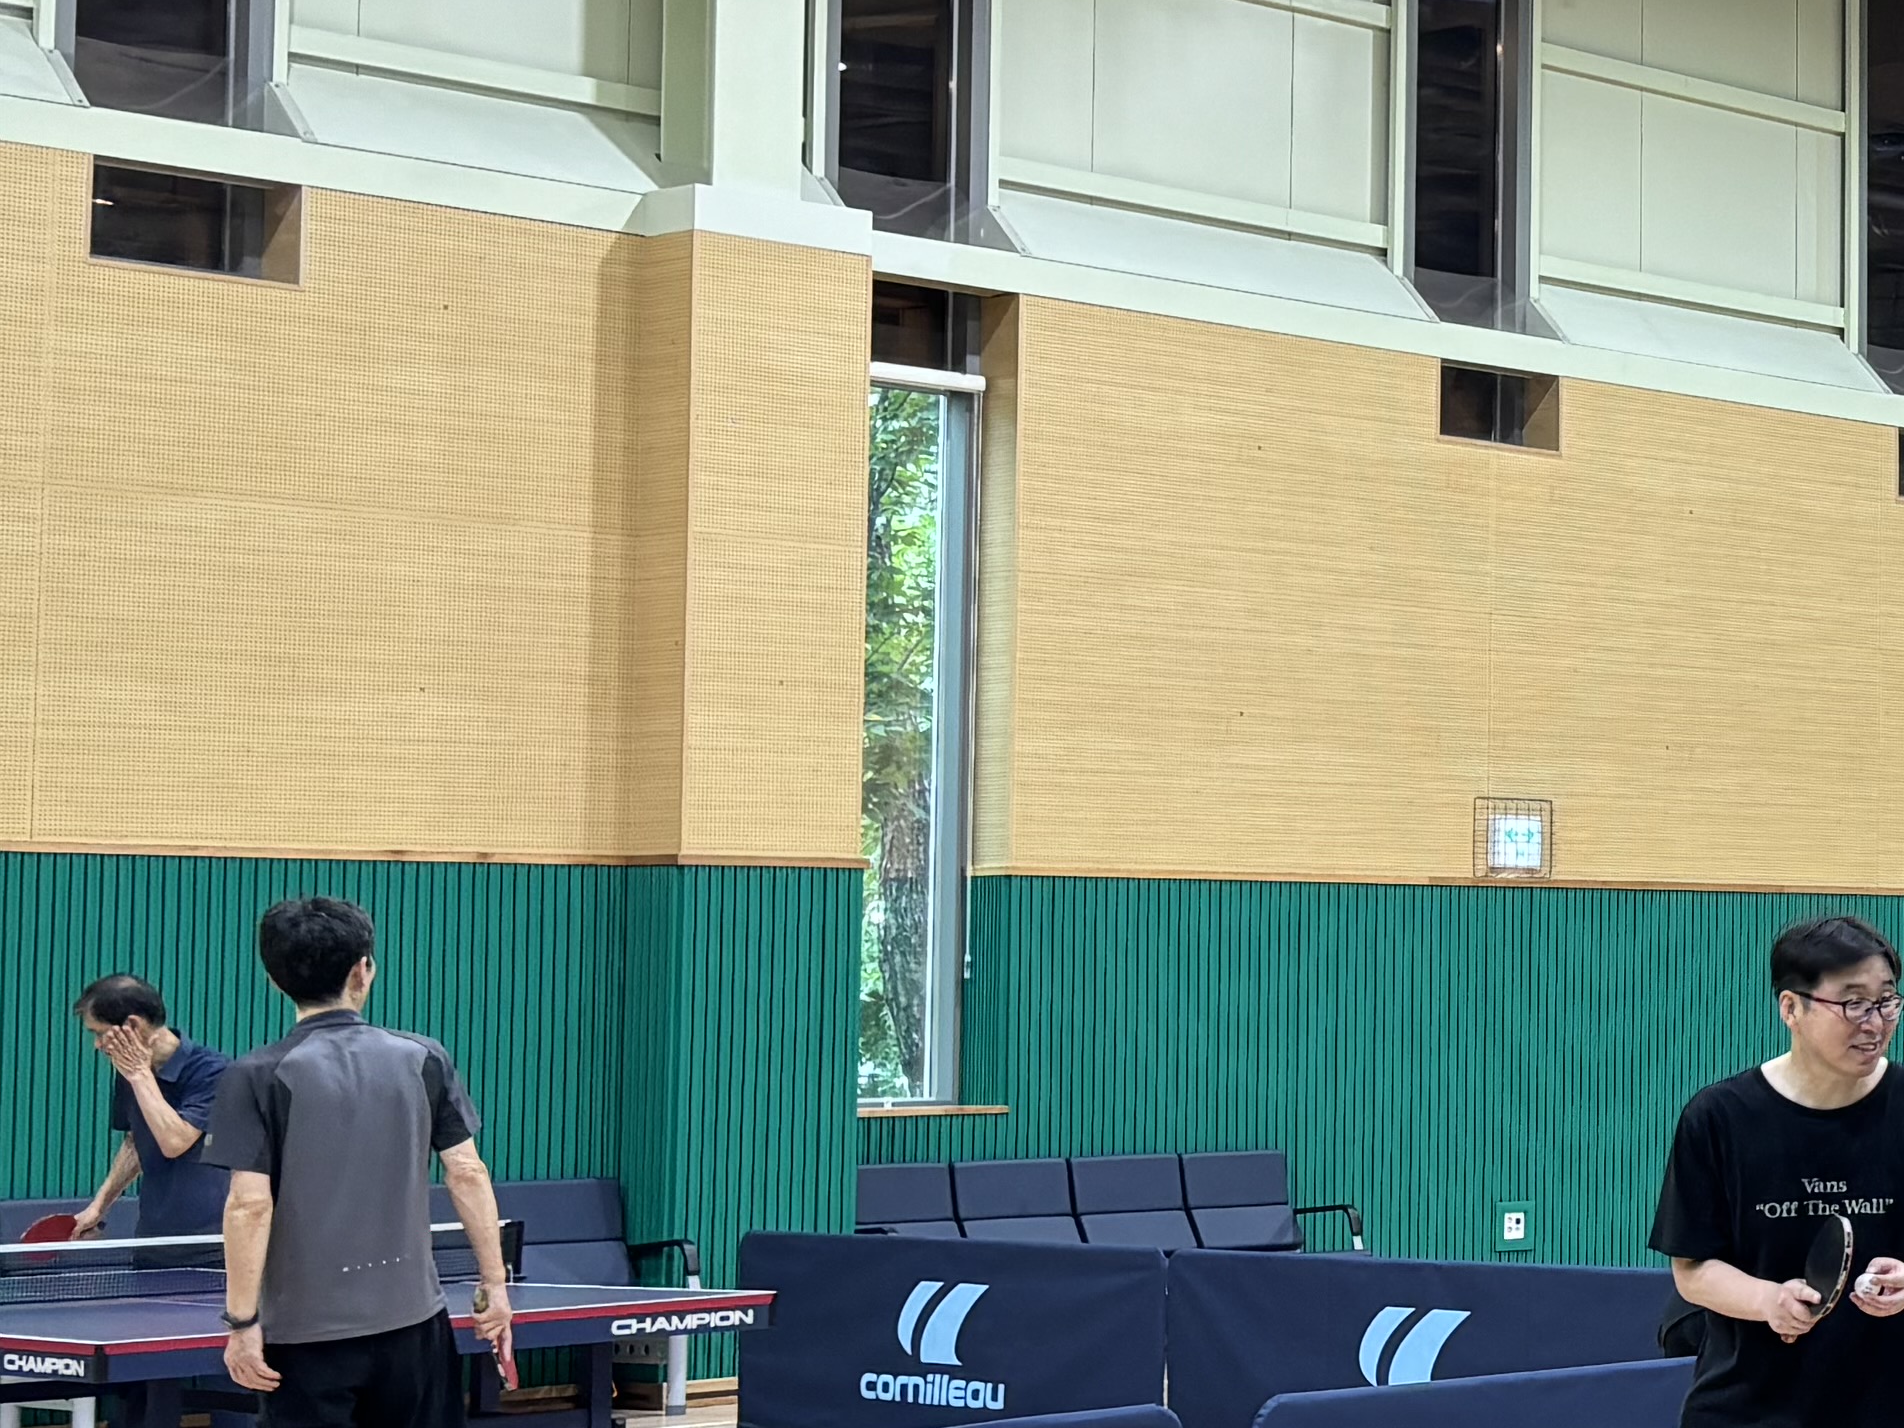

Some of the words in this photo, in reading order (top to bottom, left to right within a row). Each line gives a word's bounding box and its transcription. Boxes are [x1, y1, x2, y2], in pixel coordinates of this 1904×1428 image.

[1801, 1177, 1848, 1194] Vans
[1803, 1199, 1840, 1216] The
[611, 1308, 754, 1336] CHAMPION
[3, 1353, 85, 1377] CHAMPION
[860, 1372, 1006, 1411] cornilleau
